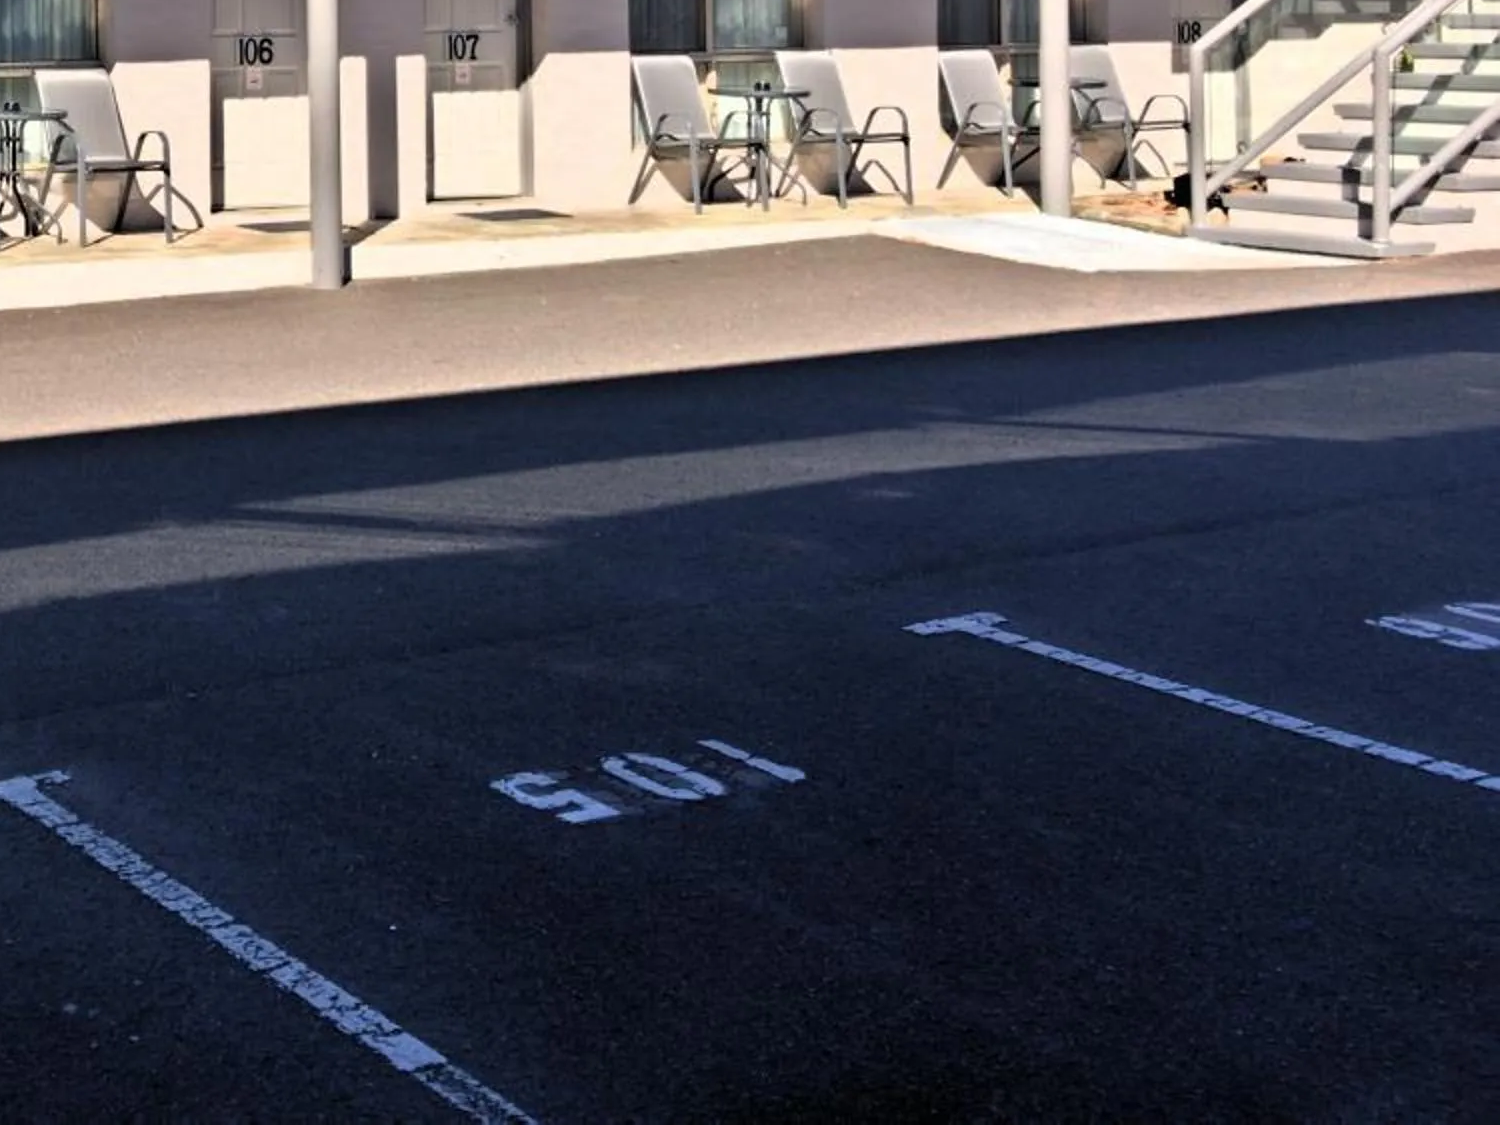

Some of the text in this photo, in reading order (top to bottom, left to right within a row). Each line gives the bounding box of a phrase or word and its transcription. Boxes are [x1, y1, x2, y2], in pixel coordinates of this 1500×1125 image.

[1177, 20, 1202, 44] 108
[238, 37, 273, 66] 106
[448, 34, 479, 61] 107
[489, 738, 806, 824] 105
